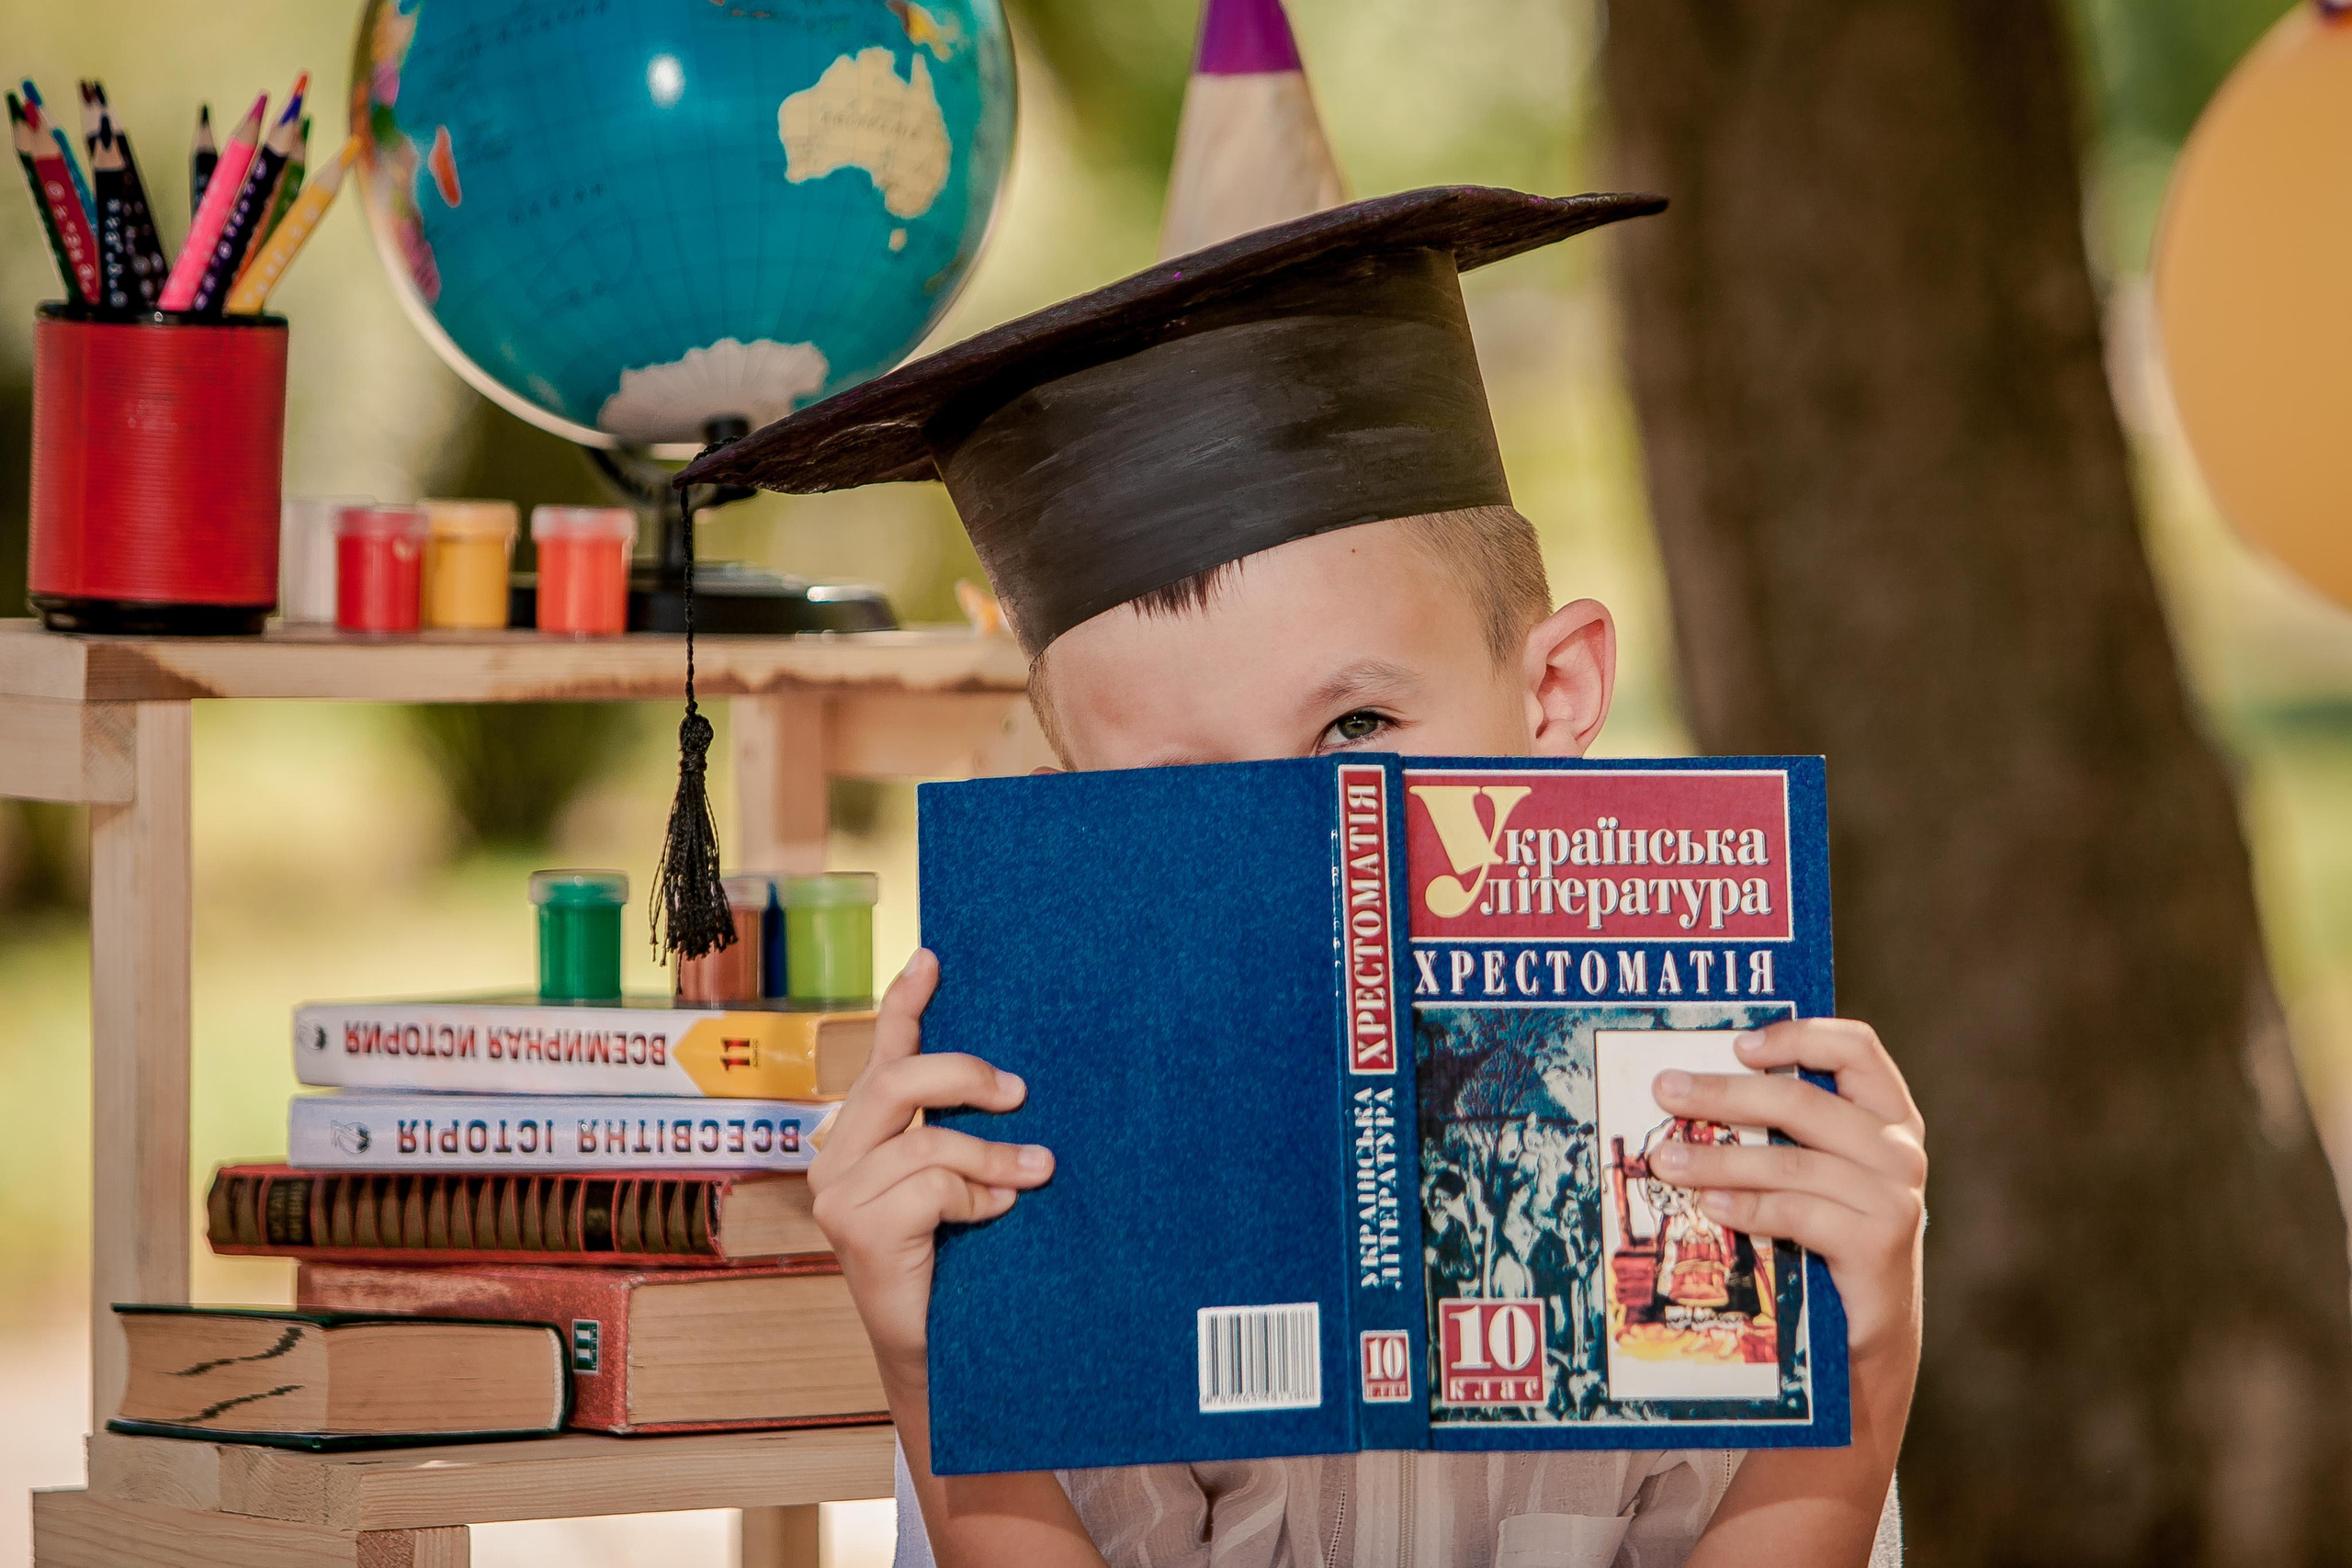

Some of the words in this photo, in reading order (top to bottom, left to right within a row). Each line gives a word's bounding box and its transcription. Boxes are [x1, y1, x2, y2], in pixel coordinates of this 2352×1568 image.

[1408, 785, 1770, 919] Українська
[1479, 866, 1773, 931] література
[1347, 784, 1388, 1064] ХРЕСТОМАТІЯ
[1412, 949, 1776, 996] ХРЕСТОМАТІЯ
[344, 1020, 476, 1058] ИСТОРИЯ
[487, 1023, 667, 1066] ВСЕМИРНАЯ
[719, 1036, 752, 1072] 11
[396, 1118, 554, 1154] ІСТОРІЯ
[576, 1118, 801, 1154] ВСЕСВІТНЯ
[1375, 1088, 1402, 1291] ЛІТЕРАТУРА
[1366, 1338, 1406, 1381] 10
[1448, 1304, 1536, 1371] 10
